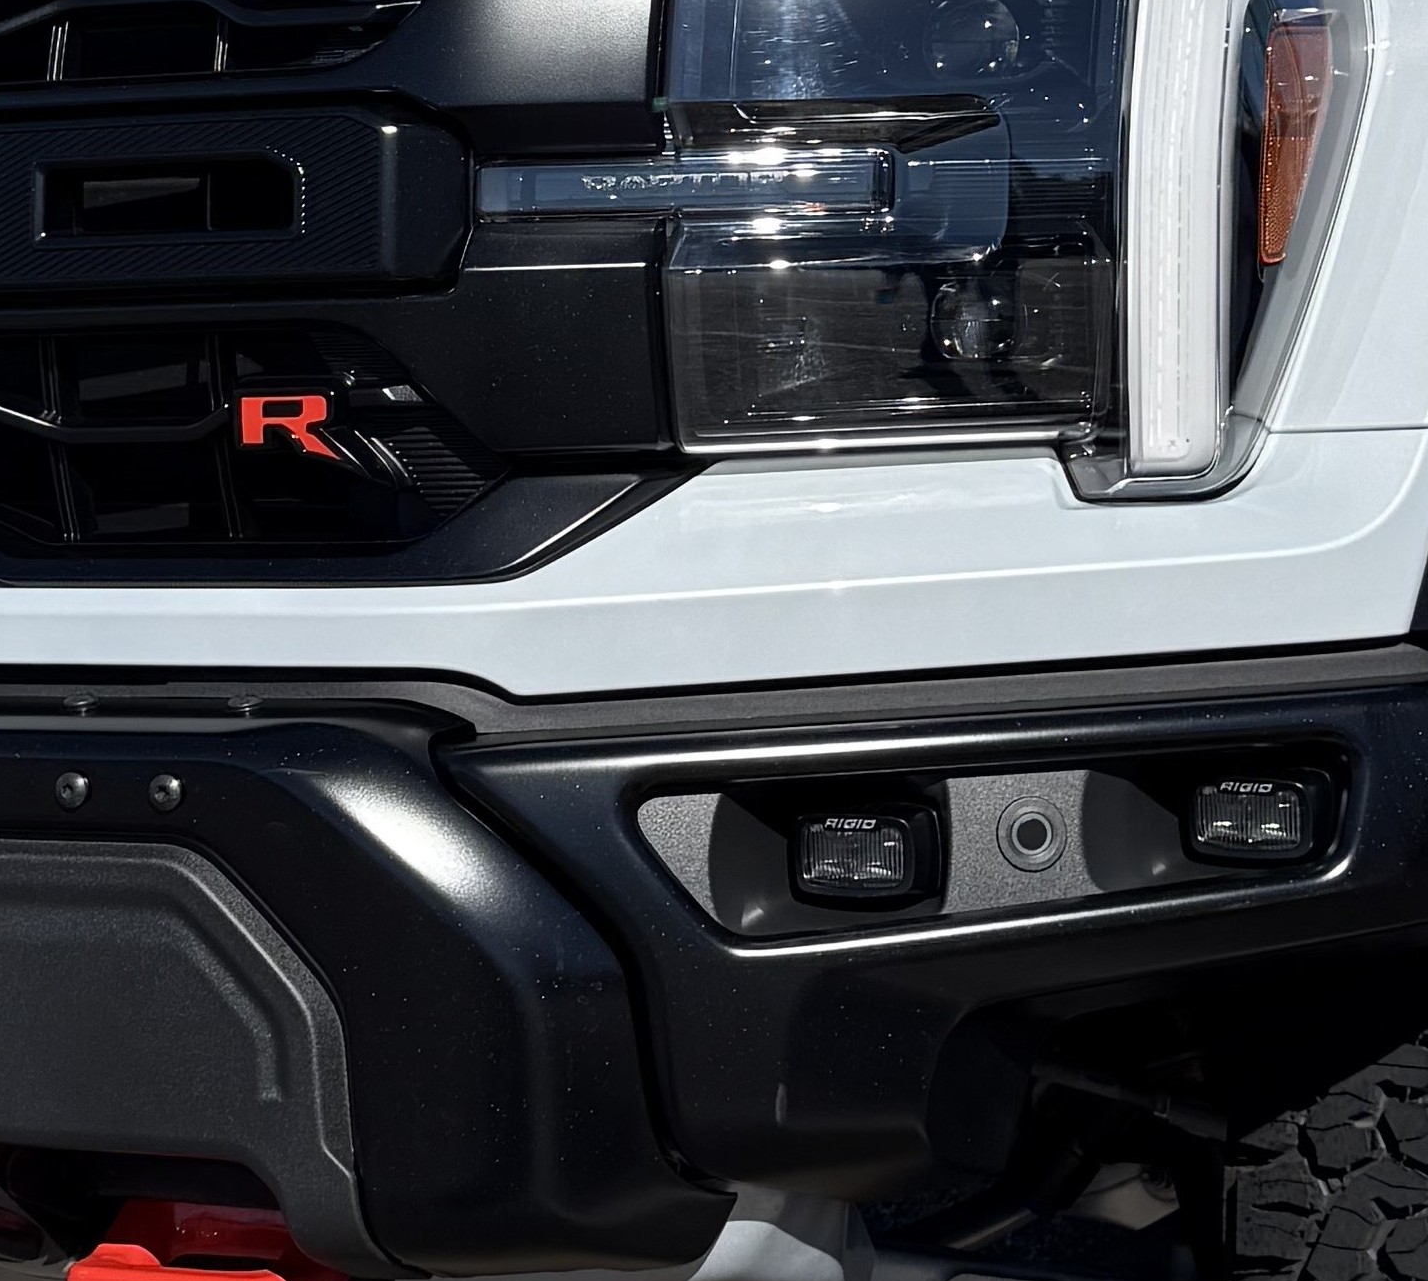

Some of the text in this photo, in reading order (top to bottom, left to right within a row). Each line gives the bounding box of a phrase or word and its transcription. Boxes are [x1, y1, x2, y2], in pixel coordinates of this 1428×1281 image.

[240, 394, 342, 461] R
[1219, 781, 1273, 793] RIGID
[824, 817, 877, 830] RIGID
